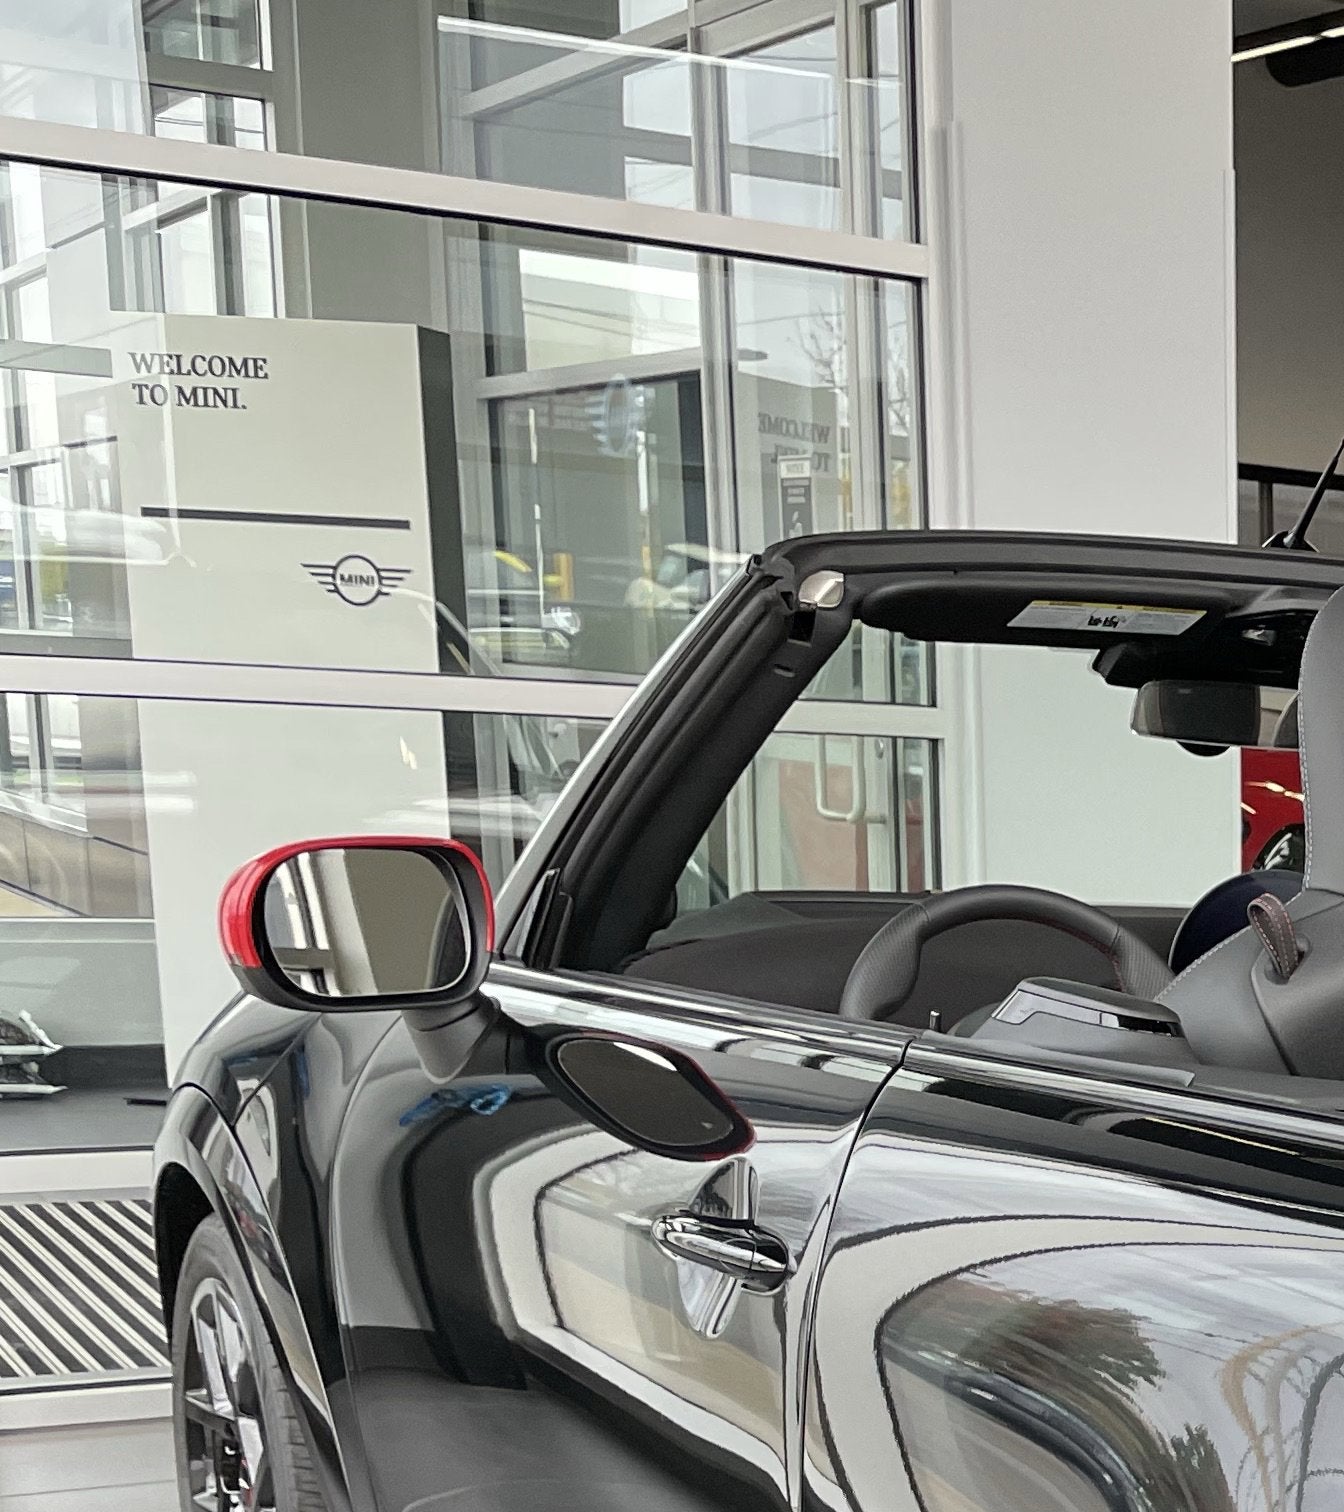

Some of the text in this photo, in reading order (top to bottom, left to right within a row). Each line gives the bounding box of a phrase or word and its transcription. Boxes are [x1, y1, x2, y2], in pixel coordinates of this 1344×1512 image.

[128, 352, 269, 380] WELCOME
[132, 383, 248, 410] TO MINI.
[339, 572, 375, 587] MINI
